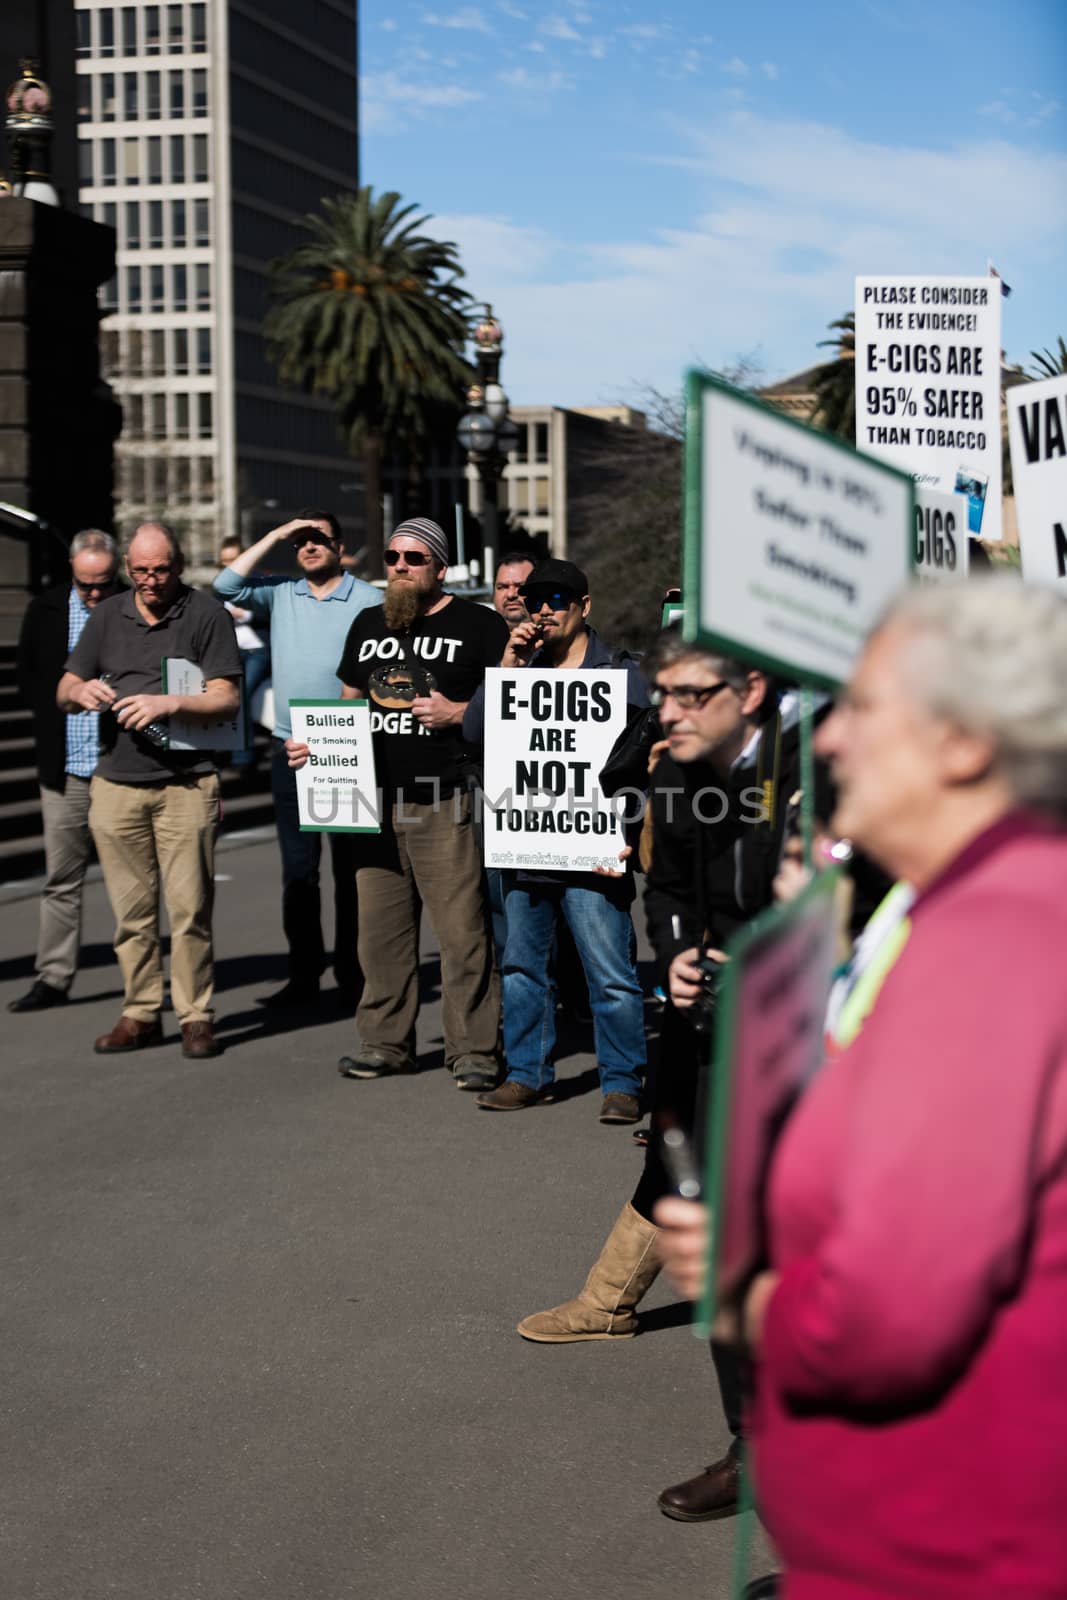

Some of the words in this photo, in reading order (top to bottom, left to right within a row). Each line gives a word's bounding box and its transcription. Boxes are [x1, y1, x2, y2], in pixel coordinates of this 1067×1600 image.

[864, 286, 916, 304] PLEASE
[921, 287, 988, 306] CONSIDER
[876, 312, 903, 330] THE
[908, 313, 977, 332] EVIDENCE!
[867, 343, 942, 374] E-CIGS
[946, 346, 983, 376] ARE
[866, 386, 917, 416] 95%
[924, 388, 983, 420] SAFER
[867, 426, 910, 445] THAN
[915, 428, 986, 450] TOBACCO
[1018, 392, 1067, 465] VA
[501, 680, 612, 722] E-CIGS
[306, 714, 355, 727] Bullied
[307, 736, 320, 745] For
[322, 737, 358, 746] Smoking
[529, 728, 576, 752] ARE
[309, 754, 359, 767] Bullied
[313, 776, 326, 784] For
[327, 777, 358, 786] Quitting
[515, 760, 591, 797] NOT
[495, 808, 617, 835] TOBACCO!
